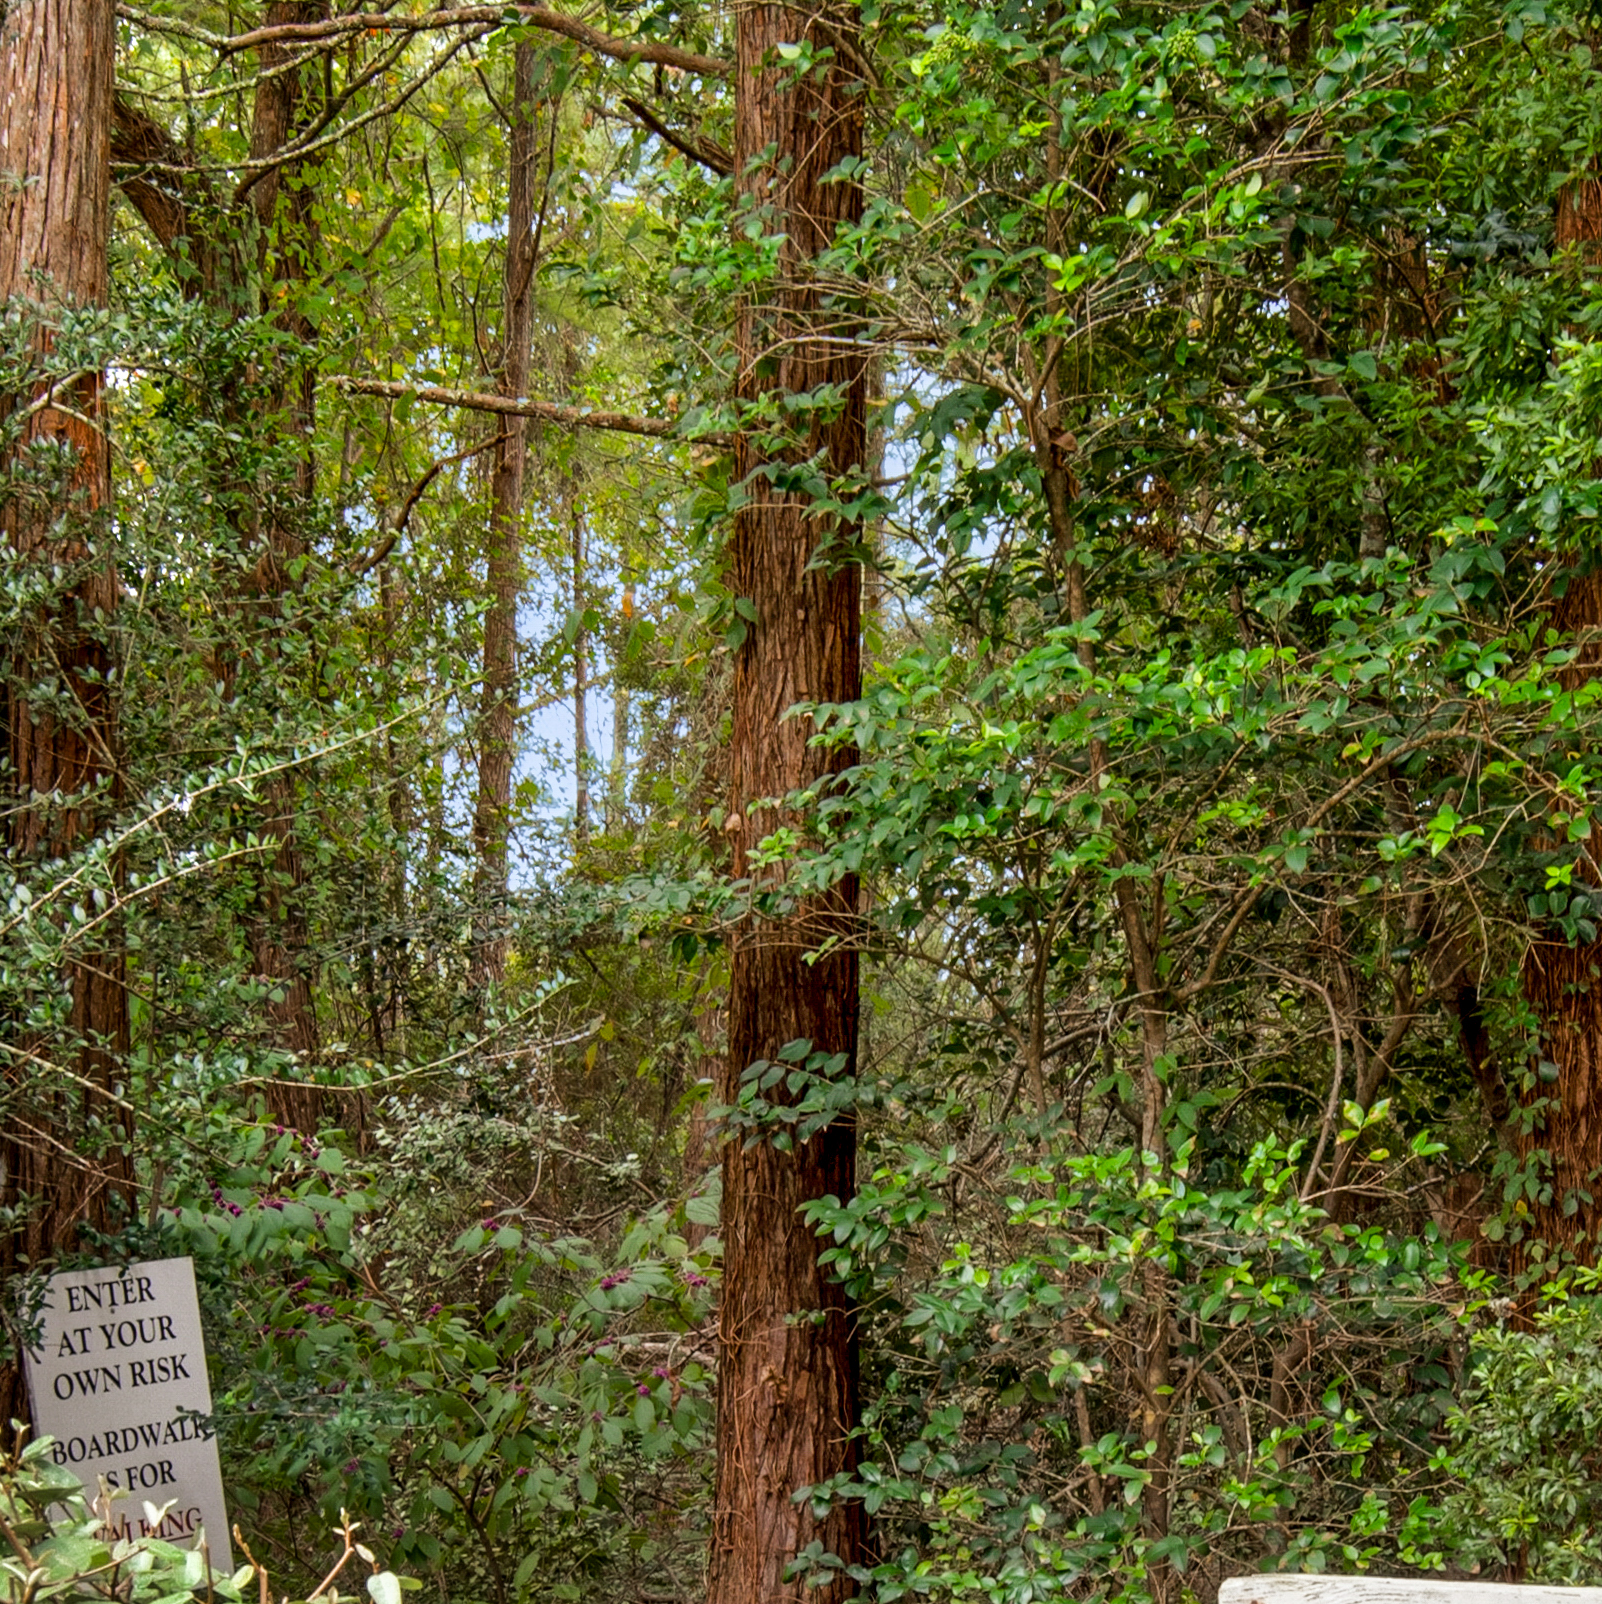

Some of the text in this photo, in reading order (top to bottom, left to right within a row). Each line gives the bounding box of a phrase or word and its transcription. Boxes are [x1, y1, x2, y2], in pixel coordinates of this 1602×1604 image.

[65, 1276, 155, 1313] ENTER
[58, 1315, 177, 1358] AT YOUR
[53, 1354, 190, 1400] OWN RISK
[125, 1460, 177, 1492] FOR
